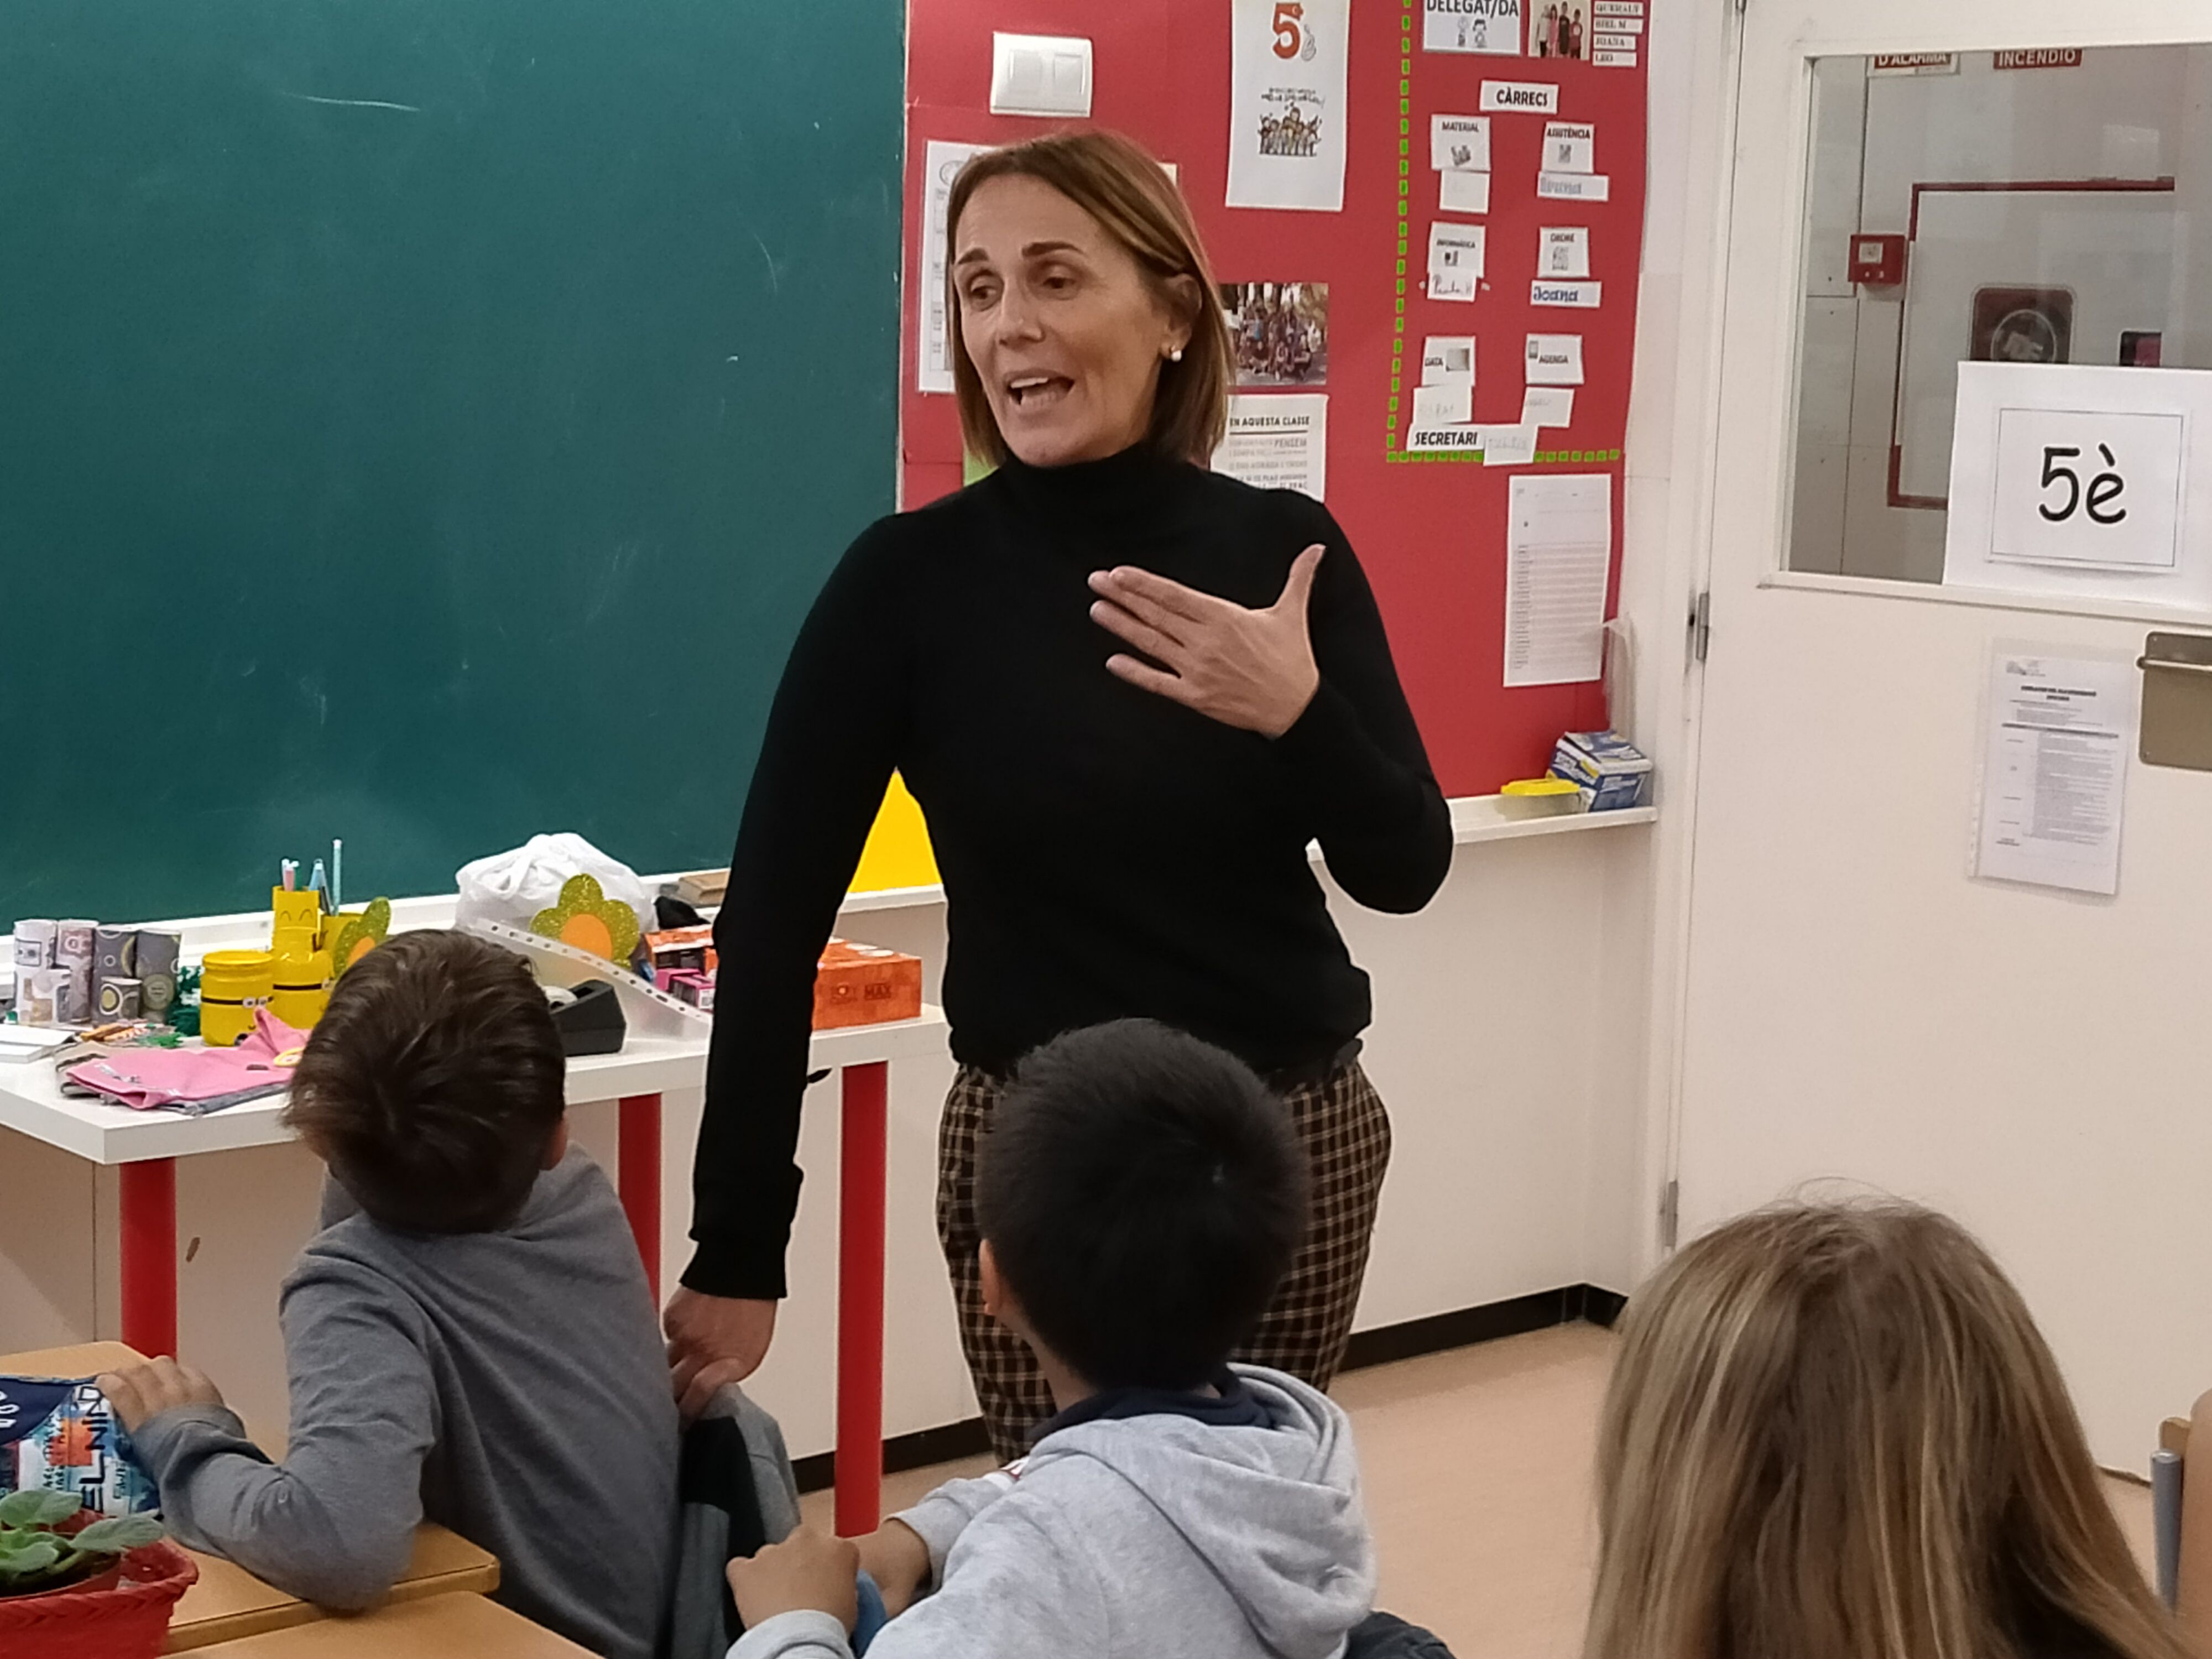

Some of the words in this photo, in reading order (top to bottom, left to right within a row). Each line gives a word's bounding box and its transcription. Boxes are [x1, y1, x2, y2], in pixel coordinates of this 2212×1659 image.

[1998, 49, 2076, 66] INCENDIO
[1496, 87, 1548, 106] CÀRRECS
[1442, 121, 1479, 133] MATERIAL
[1533, 286, 1578, 302] Joana
[1229, 418, 1239, 427] EN
[1241, 417, 1280, 427] AQUESTA
[1282, 416, 1310, 426] CLASSE
[1415, 431, 1478, 446] SECRETARI
[2039, 442, 2127, 524] 5è
